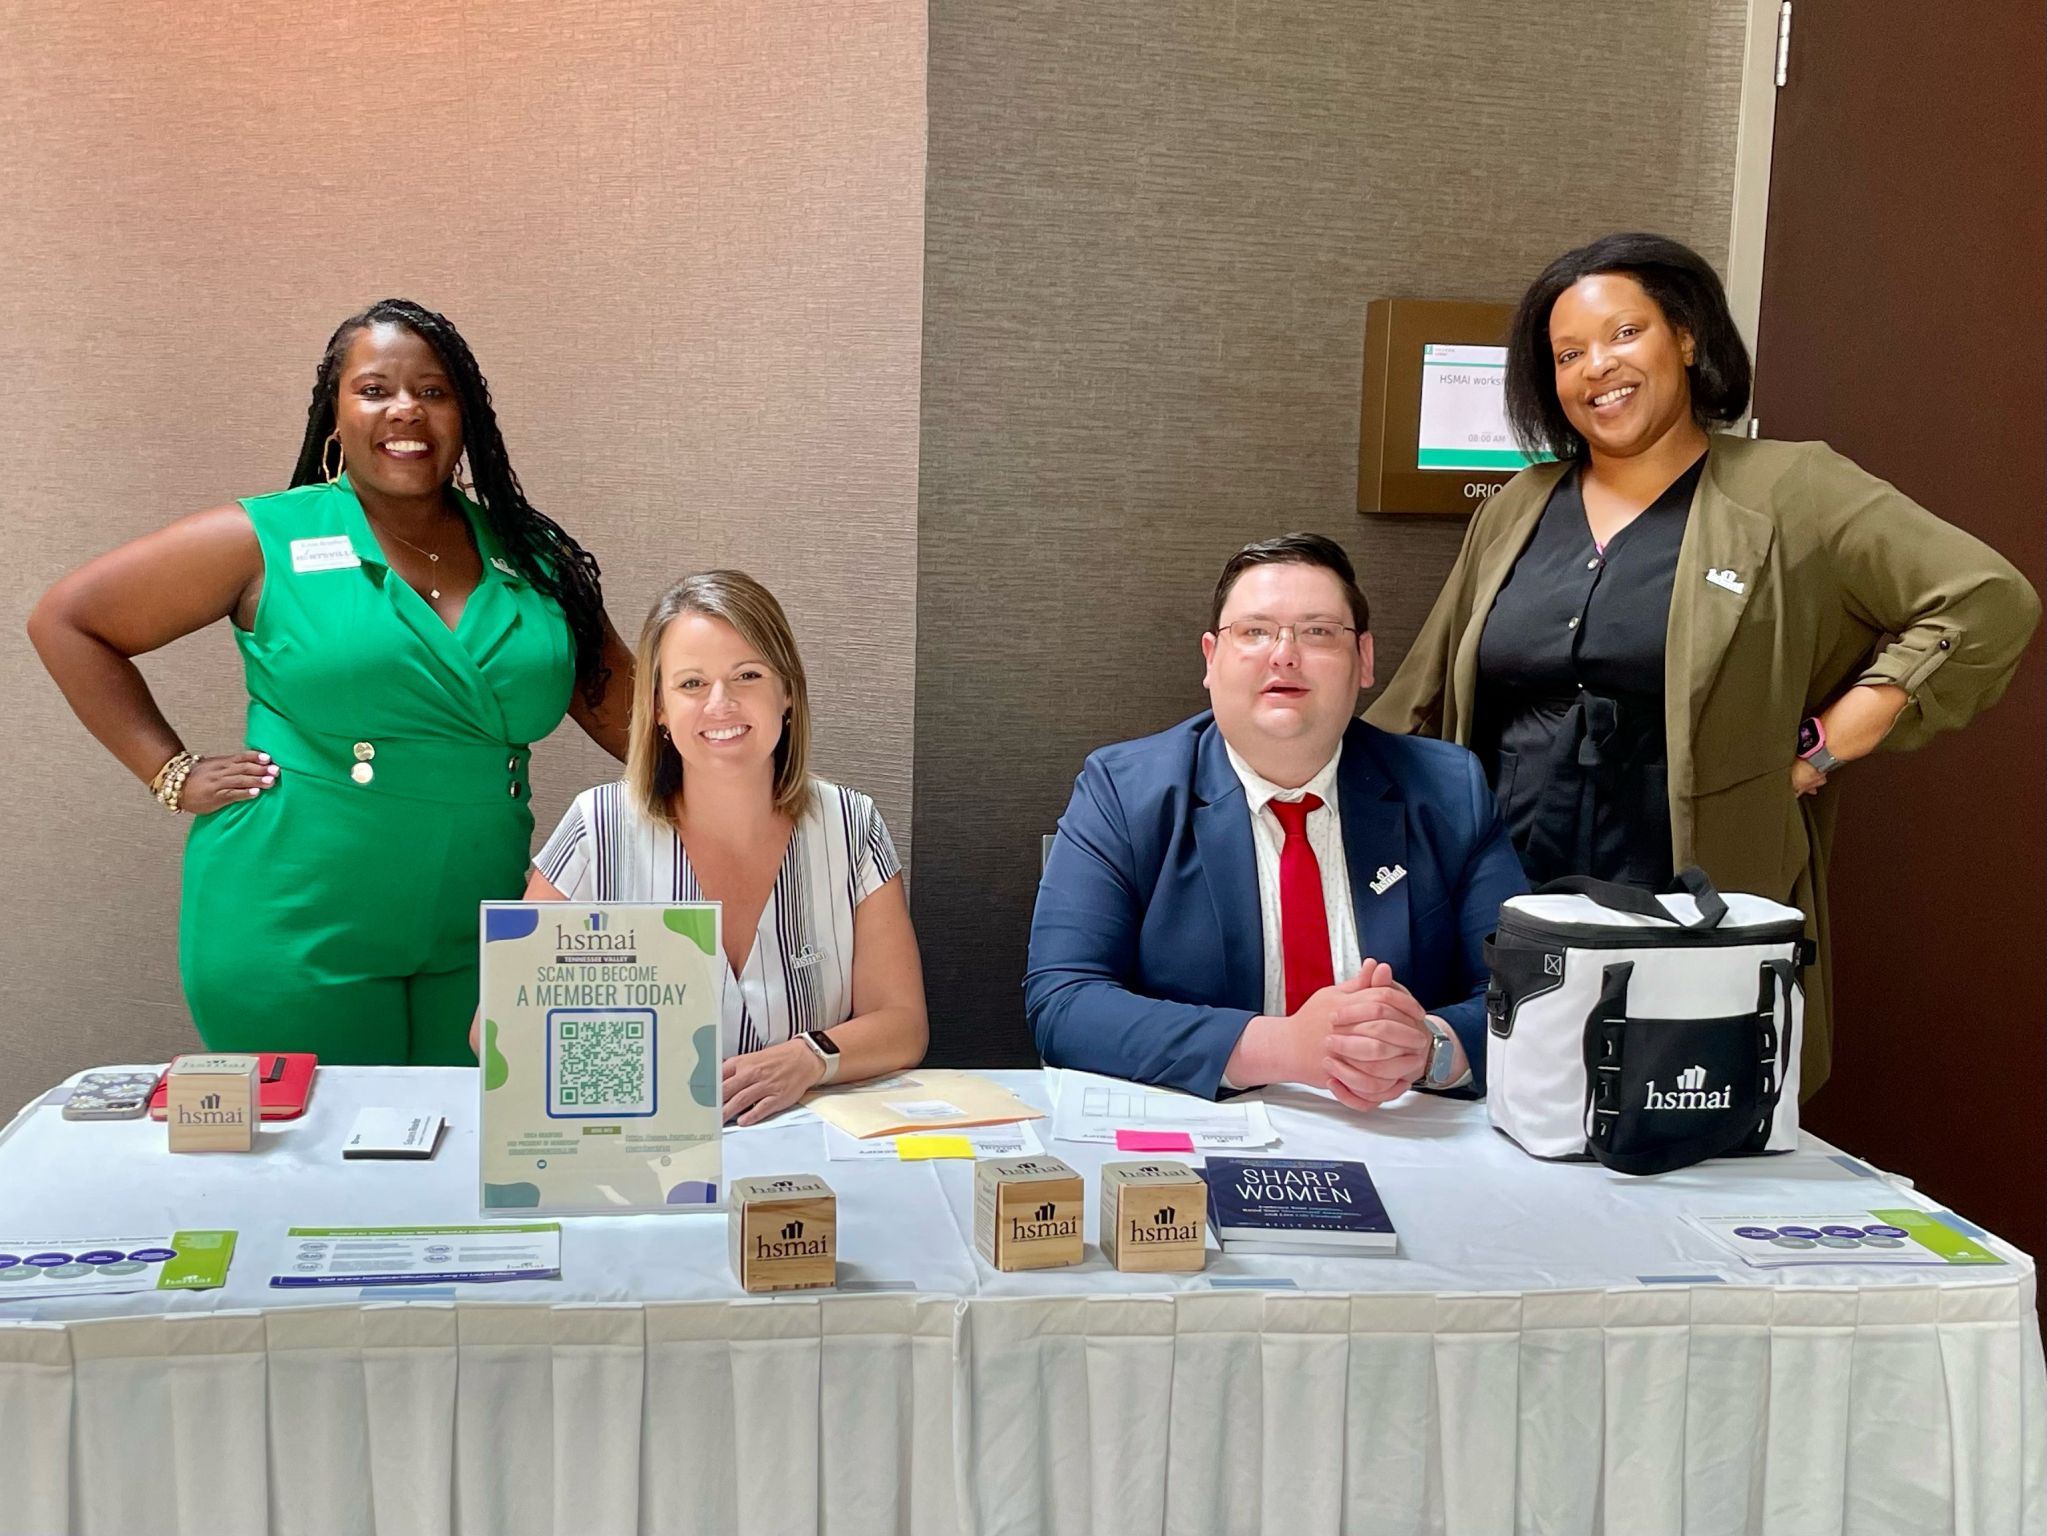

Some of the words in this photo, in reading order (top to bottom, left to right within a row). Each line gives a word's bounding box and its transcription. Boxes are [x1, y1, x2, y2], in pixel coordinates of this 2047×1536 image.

[1439, 374, 1471, 385] HSMAI
[555, 923, 637, 951] hsmai
[537, 966, 575, 983] SCAN
[579, 966, 597, 983] TO
[602, 965, 658, 983] BECOME
[516, 985, 529, 1007] A
[536, 984, 617, 1007] MEMBER
[624, 983, 687, 1006] TODAY
[1643, 1080, 1732, 1110] hsmai
[178, 1103, 243, 1124] hsmai
[996, 1164, 1066, 1176] hsmai
[1118, 1169, 1191, 1178] hsmai
[1242, 1168, 1341, 1187] SHARP
[749, 1182, 823, 1194] hsmai
[1235, 1183, 1353, 1204] WOMEN
[1011, 1215, 1078, 1240] hsmai
[1130, 1219, 1198, 1242] hsmai
[755, 1234, 828, 1259] hsmai
